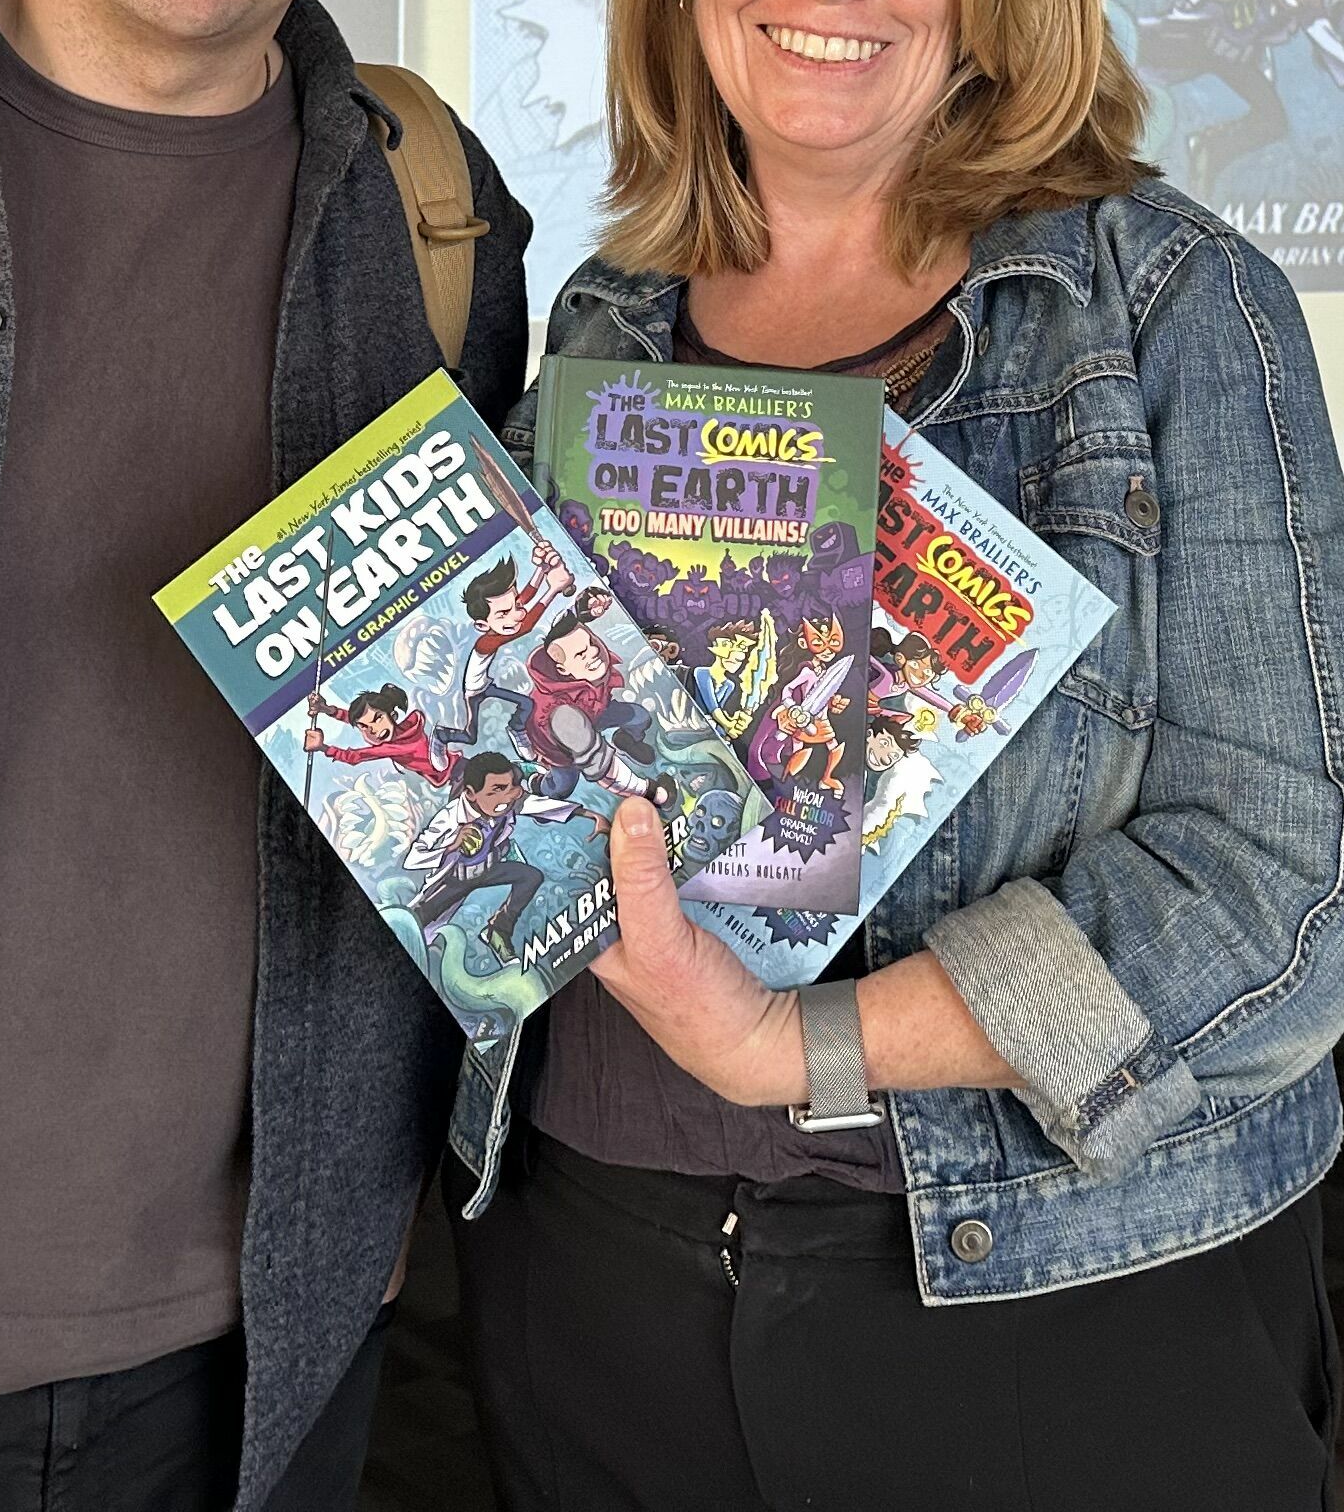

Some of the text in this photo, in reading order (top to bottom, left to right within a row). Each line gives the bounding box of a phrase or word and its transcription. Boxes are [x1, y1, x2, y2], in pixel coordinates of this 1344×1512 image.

[1220, 201, 1289, 235] MAX
[1269, 245, 1333, 267] BRIAN
[665, 391, 815, 419] MAX BRALLIER'S
[666, 379, 680, 389] The
[724, 383, 741, 393] New
[744, 384, 758, 394] York
[760, 385, 781, 396] Times
[596, 413, 824, 461] LAST COMICS
[276, 527, 288, 541] #1
[288, 510, 310, 534] New
[309, 492, 331, 512] York
[329, 474, 357, 498] Times
[354, 442, 401, 477] bestselling
[594, 463, 811, 519] ON EARTH
[942, 483, 955, 500] The
[954, 496, 973, 514] New
[971, 510, 989, 527] York
[987, 523, 1008, 544] Times
[212, 429, 467, 647] LAST KIDS
[600, 508, 811, 545] TOO MANY VILLAINS!
[920, 488, 1043, 595] MAX BRALLIER'S
[256, 472, 496, 678] ON EARTH
[925, 535, 1032, 632] COMICS
[324, 550, 471, 668] THE GRAPHIC NOVEL
[775, 795, 835, 828] FULL COLOR
[779, 816, 819, 836] GRAPHIC
[705, 861, 750, 879] DOUGLAS
[756, 864, 803, 882] HOLGATE
[523, 906, 573, 972] MAX
[573, 907, 617, 955] BRIAN
[724, 915, 768, 955] HOLGATE
